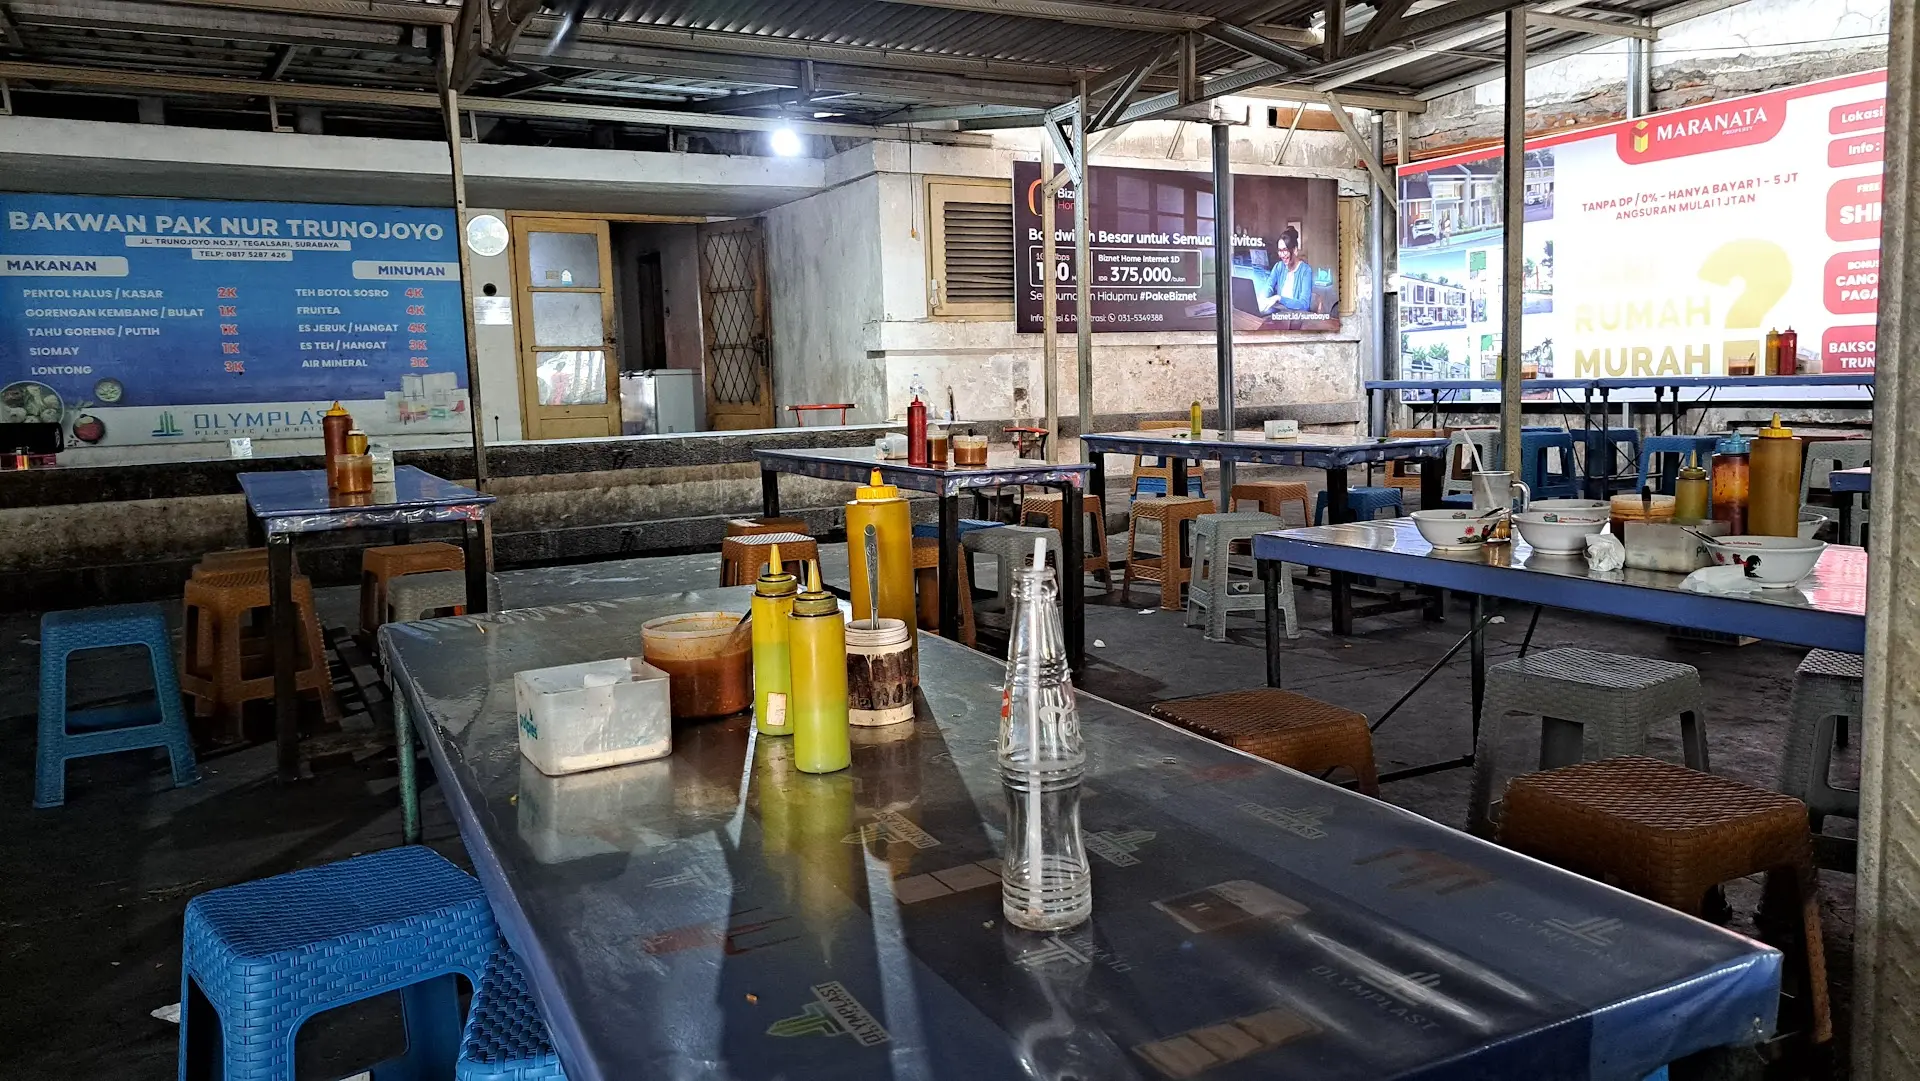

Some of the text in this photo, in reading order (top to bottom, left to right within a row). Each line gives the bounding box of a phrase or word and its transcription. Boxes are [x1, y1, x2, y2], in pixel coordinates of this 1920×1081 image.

[1841, 105, 1884, 123] Lokasi
[1656, 107, 1768, 141] MARANATA
[1582, 200, 1616, 212] TANPA
[1619, 197, 1633, 208] DP
[1642, 193, 1658, 203] 0%
[1669, 186, 1709, 200] HANYA
[1712, 180, 1753, 194] BAYAR
[1774, 175, 1781, 185] 5
[1784, 172, 1798, 183] JT
[1616, 203, 1676, 220] ANGSURAN
[1679, 199, 1715, 212] MULAI
[8, 211, 444, 241] BAKWAN PAK NUR TRUNOJOYO
[140, 238, 152, 246] JL.
[156, 238, 210, 247] TRUNOJOYO
[242, 240, 293, 249] TEGALSARI,
[295, 241, 339, 249] SURABAYA
[1098, 231, 1132, 244] Besar
[1136, 232, 1170, 245] untuk
[1173, 233, 1212, 246] Semua
[199, 250, 224, 258] TELP:
[226, 251, 245, 259] 0817
[1098, 255, 1119, 263] Biznet
[1121, 255, 1141, 263] Home
[6, 260, 97, 272] MAKANAN
[378, 265, 445, 276] MINUMAN
[23, 288, 164, 300] PENTOL HALUS / KASAR
[217, 287, 238, 299] 2K
[295, 289, 389, 298] TEH BOTOL SOSRO
[405, 288, 424, 299] 4K
[1098, 292, 1138, 303] Hidupmu
[1140, 291, 1197, 301] #PakeBiznet
[25, 306, 205, 319] GORENGAN KEMBANG / BULAT
[219, 305, 237, 317] 1K
[297, 307, 341, 315] FRUITEA
[406, 305, 425, 316] 4K
[1575, 296, 1711, 333] RUMAH
[1118, 314, 1163, 322] 031-5349388
[27, 326, 160, 338] TAHU GORENG / PUTIH
[220, 324, 238, 336] 1K
[299, 323, 398, 334] ES JERUK / HANGAT
[407, 323, 427, 333] 4K
[222, 342, 240, 354] 1K
[300, 342, 312, 350] ES
[315, 342, 334, 350] TEH
[342, 341, 387, 350] HANGAT
[409, 339, 428, 351] 3K
[29, 347, 79, 356] SIOMAY
[302, 359, 368, 368] AIR MINERAL
[410, 357, 429, 368] 3K
[1574, 343, 1711, 378] MURAH
[31, 366, 93, 376] LONTONG
[224, 361, 245, 373] 3K
[194, 410, 327, 429] OLYMPLAS
